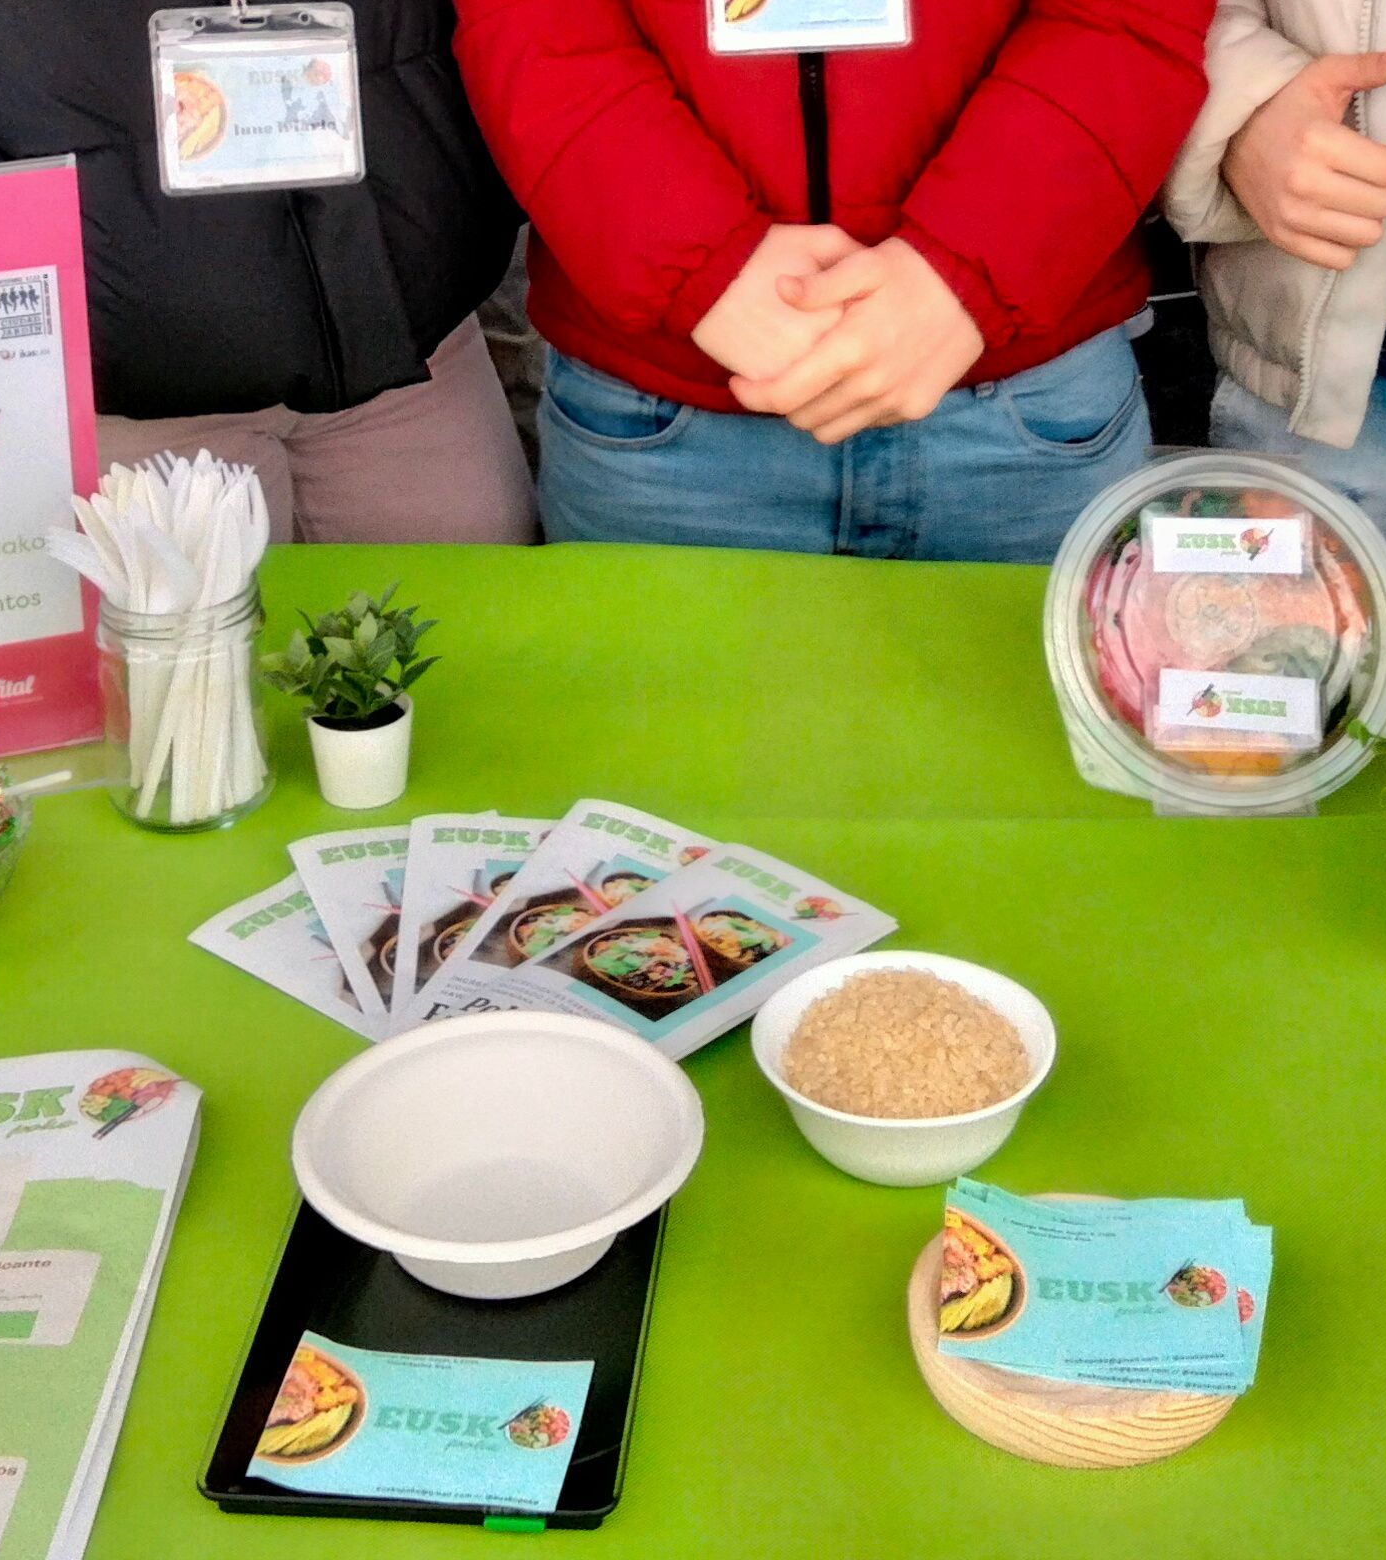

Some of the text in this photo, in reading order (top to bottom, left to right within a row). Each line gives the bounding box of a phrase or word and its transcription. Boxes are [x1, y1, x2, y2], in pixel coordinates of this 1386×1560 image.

[1176, 532, 1237, 550] EUSK
[432, 826, 531, 849] EUSK
[578, 811, 677, 855] EUSK
[713, 855, 802, 902] EUSK
[1035, 1276, 1157, 1303] EUSK
[372, 1404, 499, 1439] EUSK
